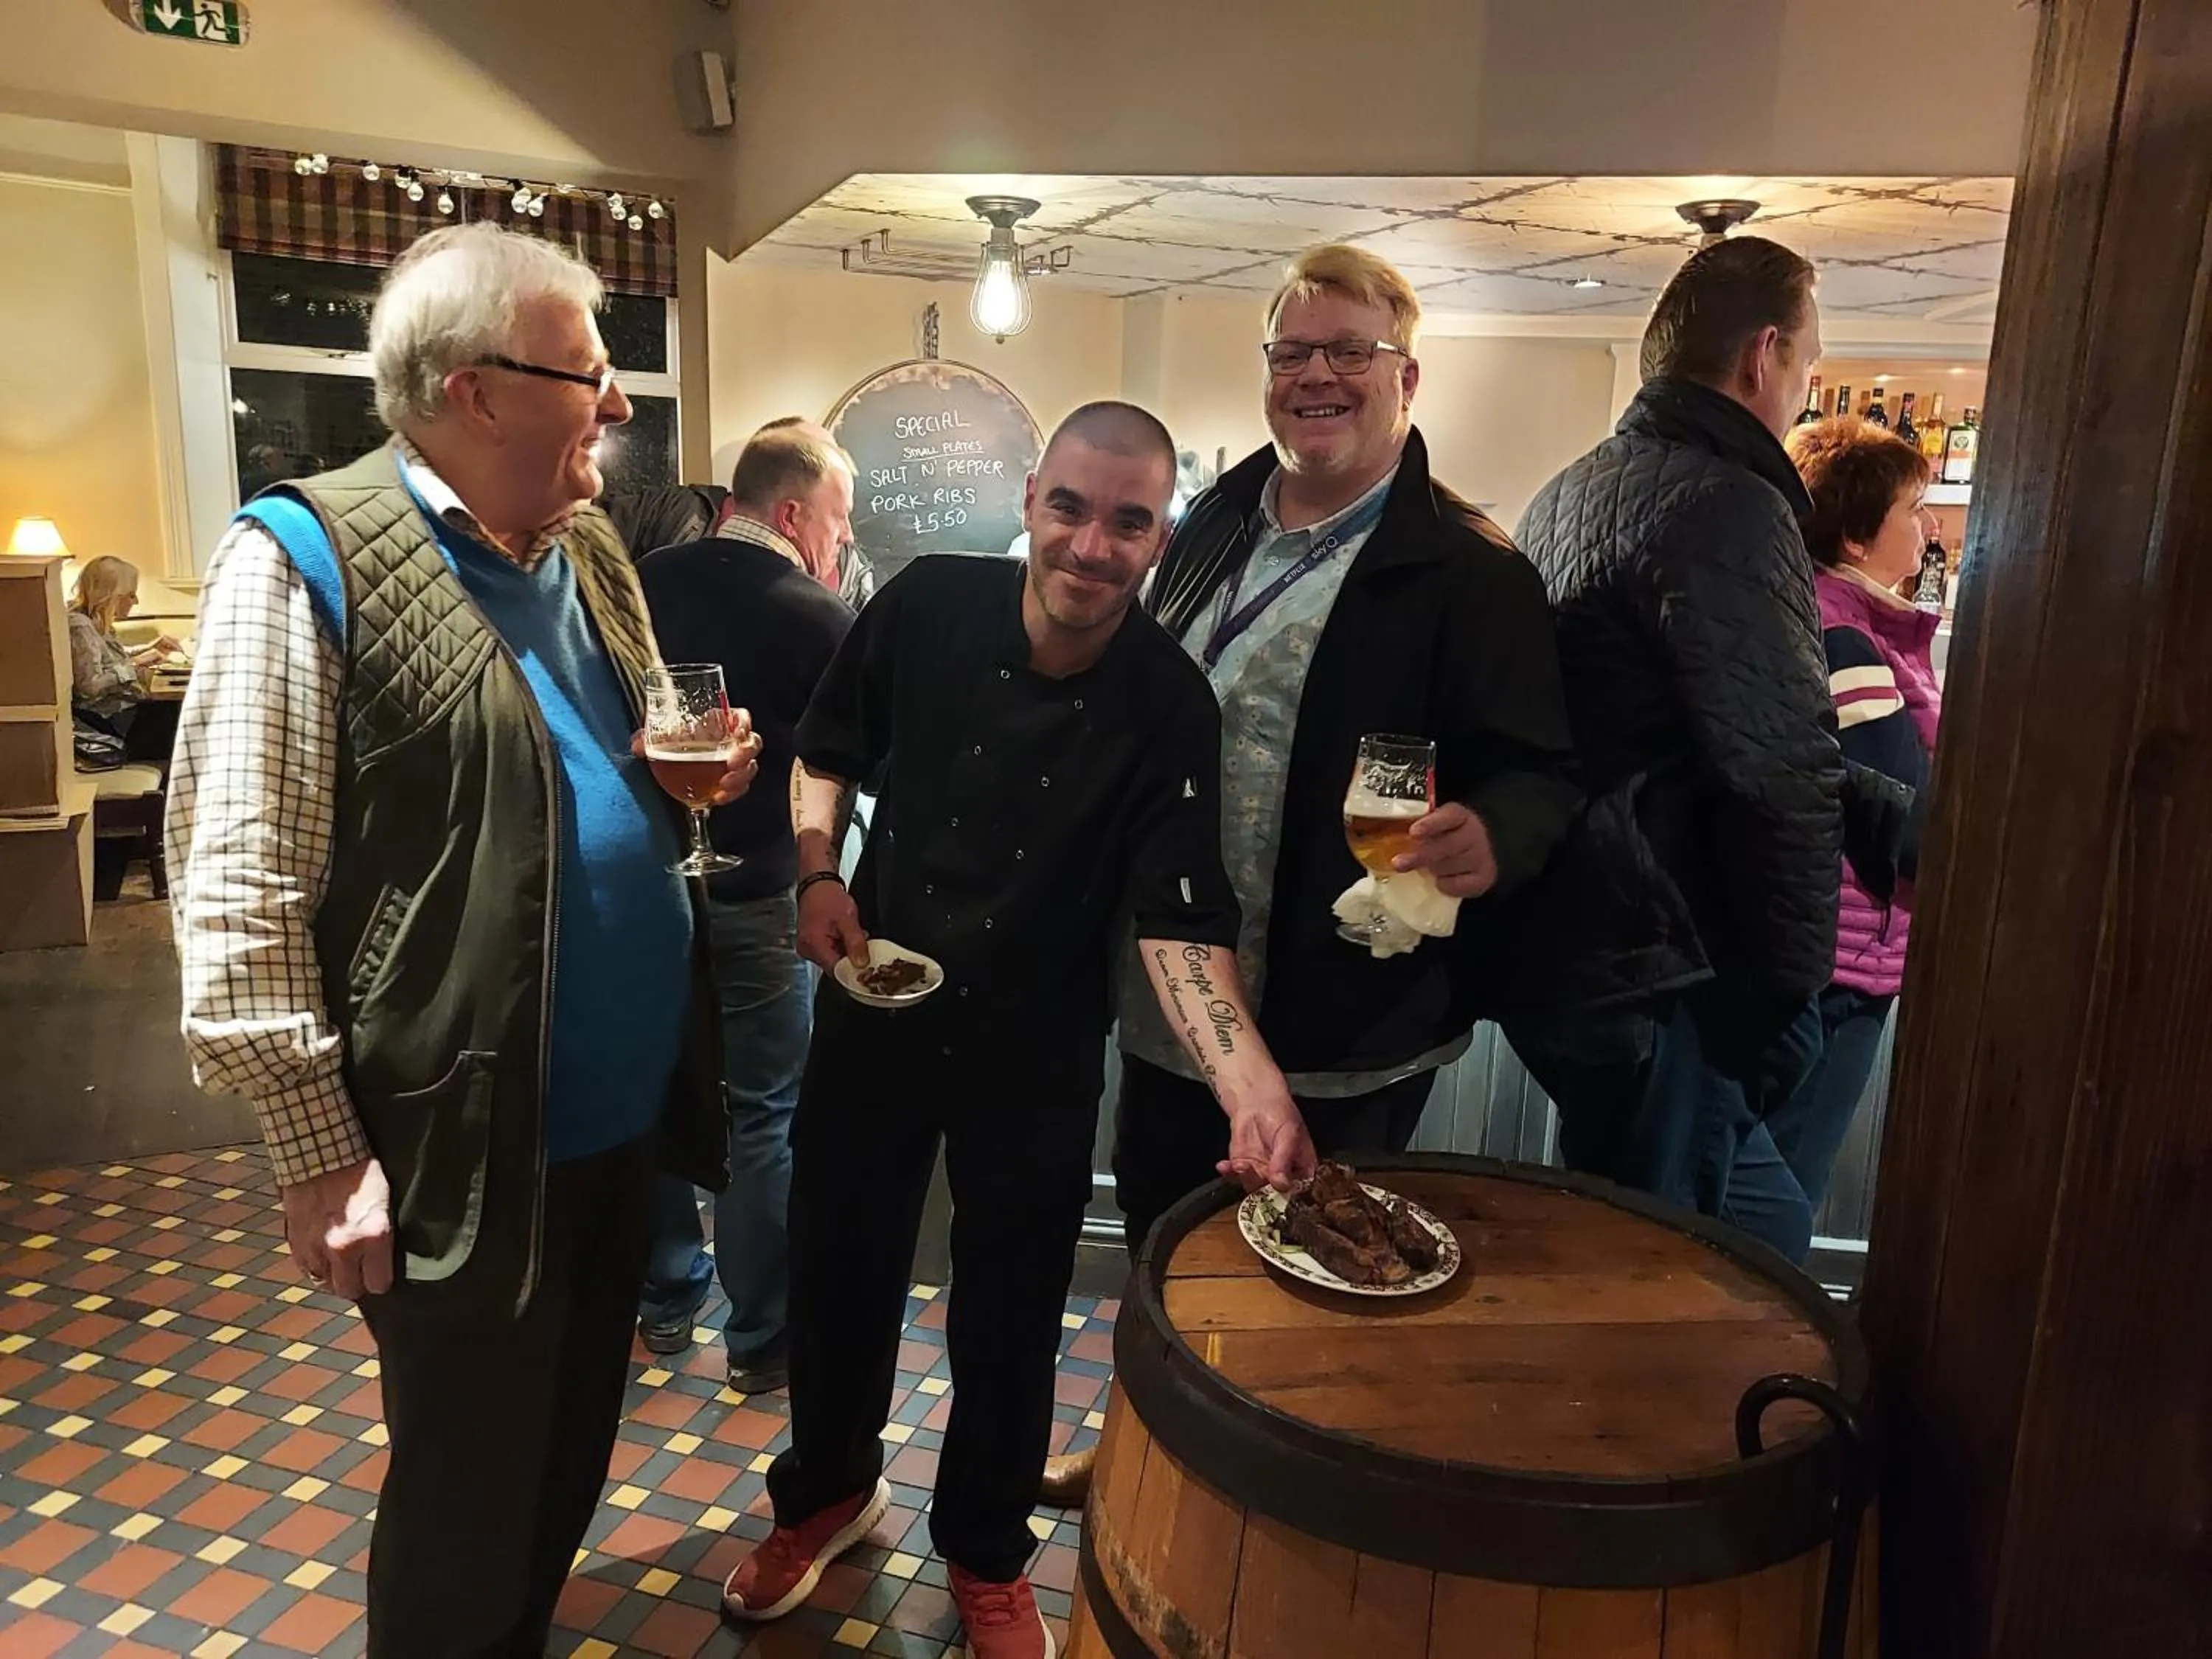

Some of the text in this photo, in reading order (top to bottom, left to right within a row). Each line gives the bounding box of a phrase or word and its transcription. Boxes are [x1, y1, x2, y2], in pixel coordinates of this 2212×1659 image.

[895, 410, 970, 439] SPECIAL
[902, 441, 982, 459] SMALL PLATES
[870, 465, 908, 488] SALT
[947, 459, 1005, 479] PEPPER
[871, 487, 976, 513] PORK RIBS
[912, 508, 967, 534] £5.50
[1182, 943, 1214, 996] Carpe
[1204, 999, 1244, 1056] Diem
